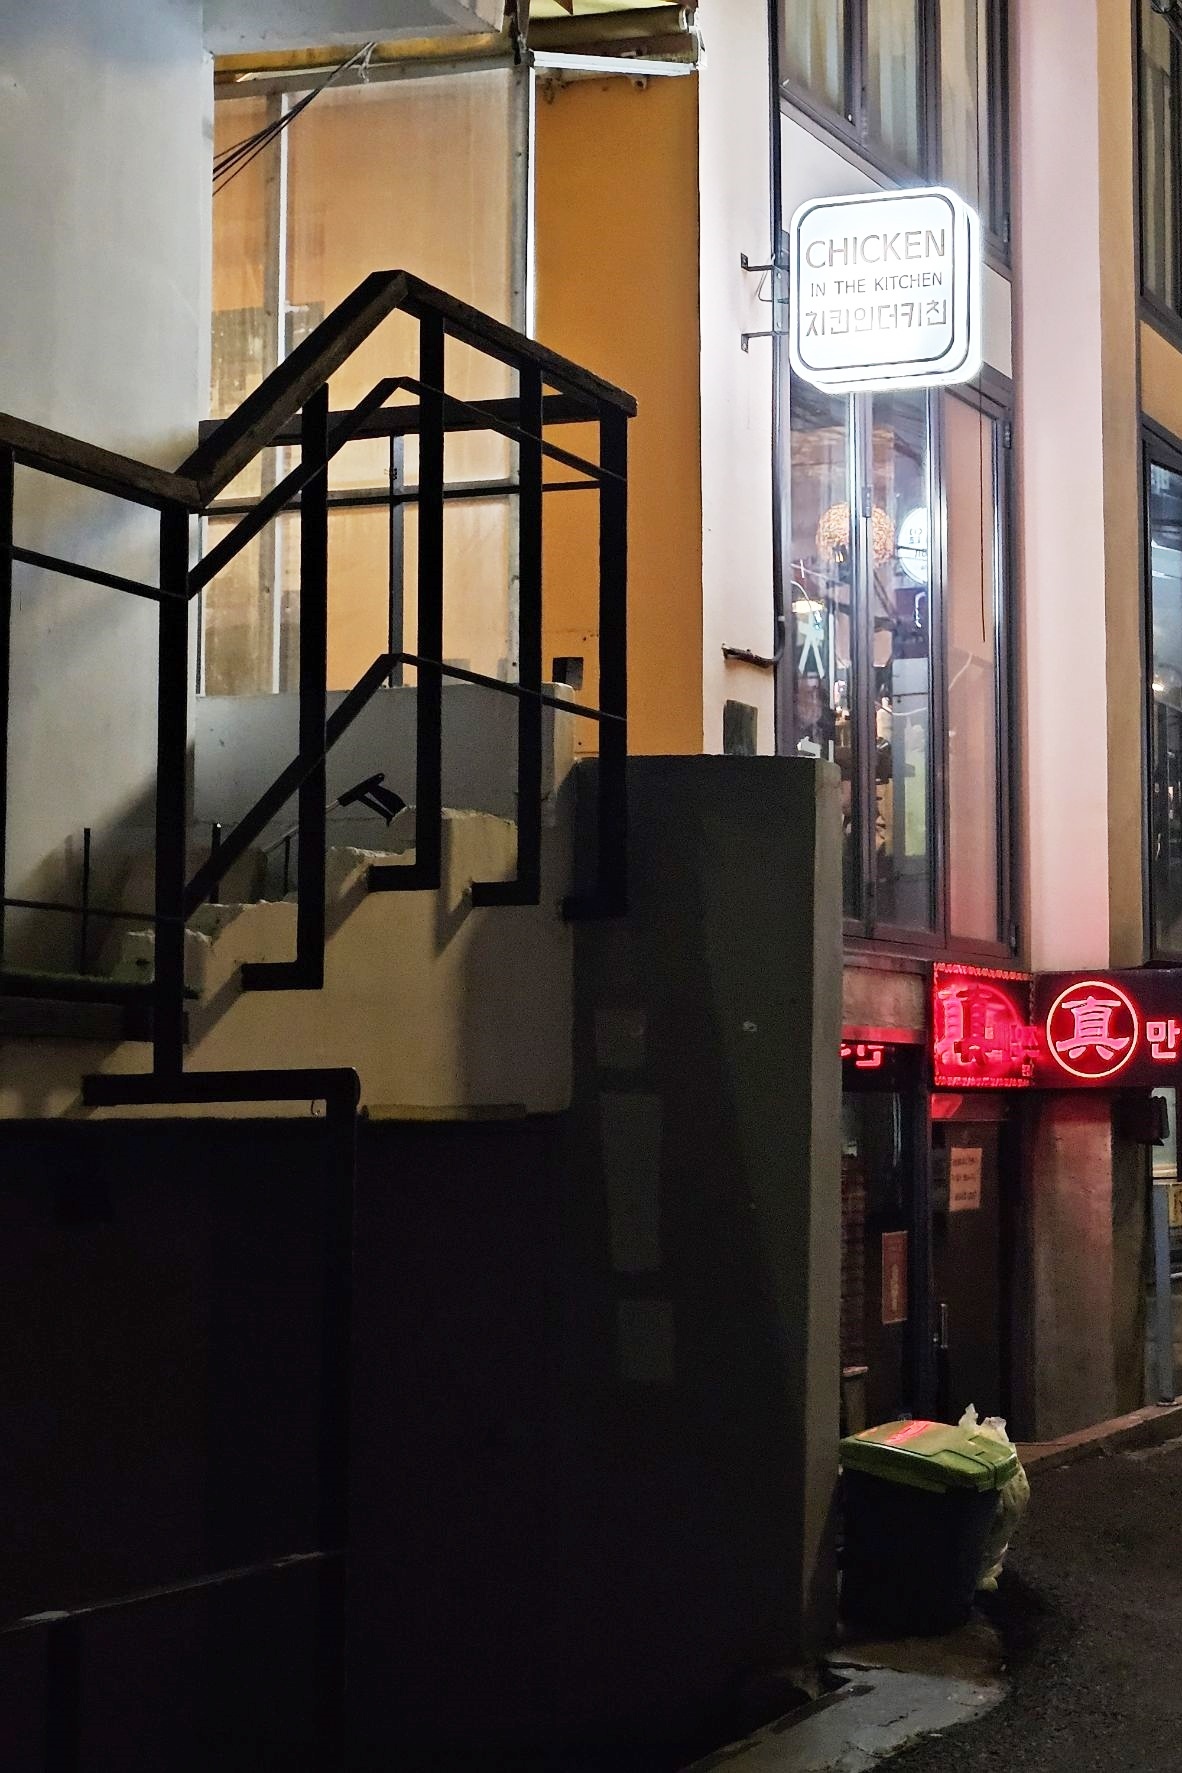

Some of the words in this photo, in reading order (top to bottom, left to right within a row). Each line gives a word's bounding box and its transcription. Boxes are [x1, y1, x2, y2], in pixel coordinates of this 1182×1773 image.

[805, 228, 945, 269] CHICKEN
[811, 282, 826, 297] IN
[834, 279, 866, 295] THE
[874, 271, 943, 291] KITCHEN
[805, 299, 947, 337] 치킨인더키친
